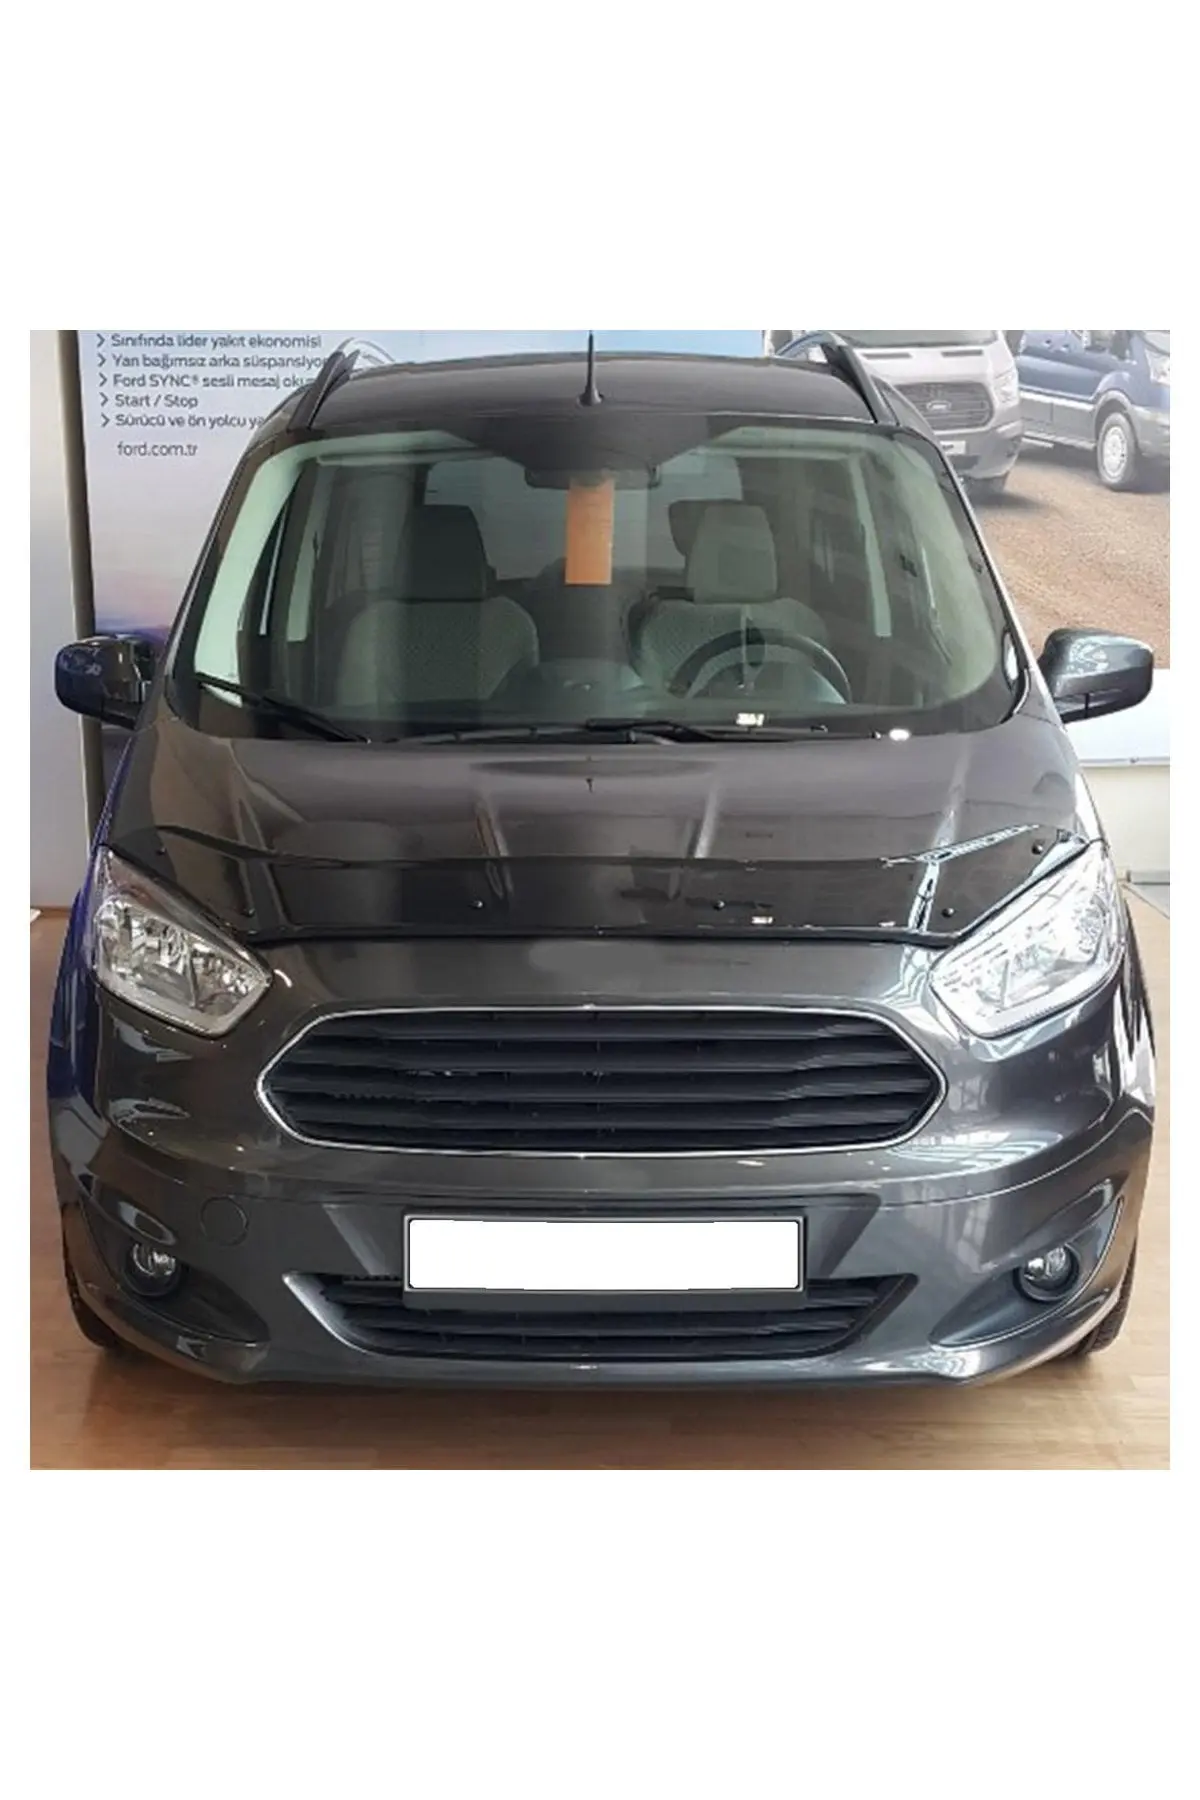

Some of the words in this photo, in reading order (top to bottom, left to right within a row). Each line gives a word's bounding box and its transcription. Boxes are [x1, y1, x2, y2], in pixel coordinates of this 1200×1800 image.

[178, 334, 208, 347] lider
[211, 335, 246, 349] yakıt
[249, 335, 321, 348] ekonomisi
[112, 353, 140, 367] Yan
[208, 355, 241, 367] arka
[113, 374, 146, 387] Ford
[202, 375, 235, 388] sesli
[239, 374, 281, 389] mesaj
[115, 394, 150, 407] Start
[153, 393, 162, 408] /
[163, 394, 199, 409] Stop
[167, 416, 185, 427] ve
[187, 415, 206, 427] ön
[208, 415, 246, 430] yolcu
[117, 441, 198, 457] ford.com.tr
